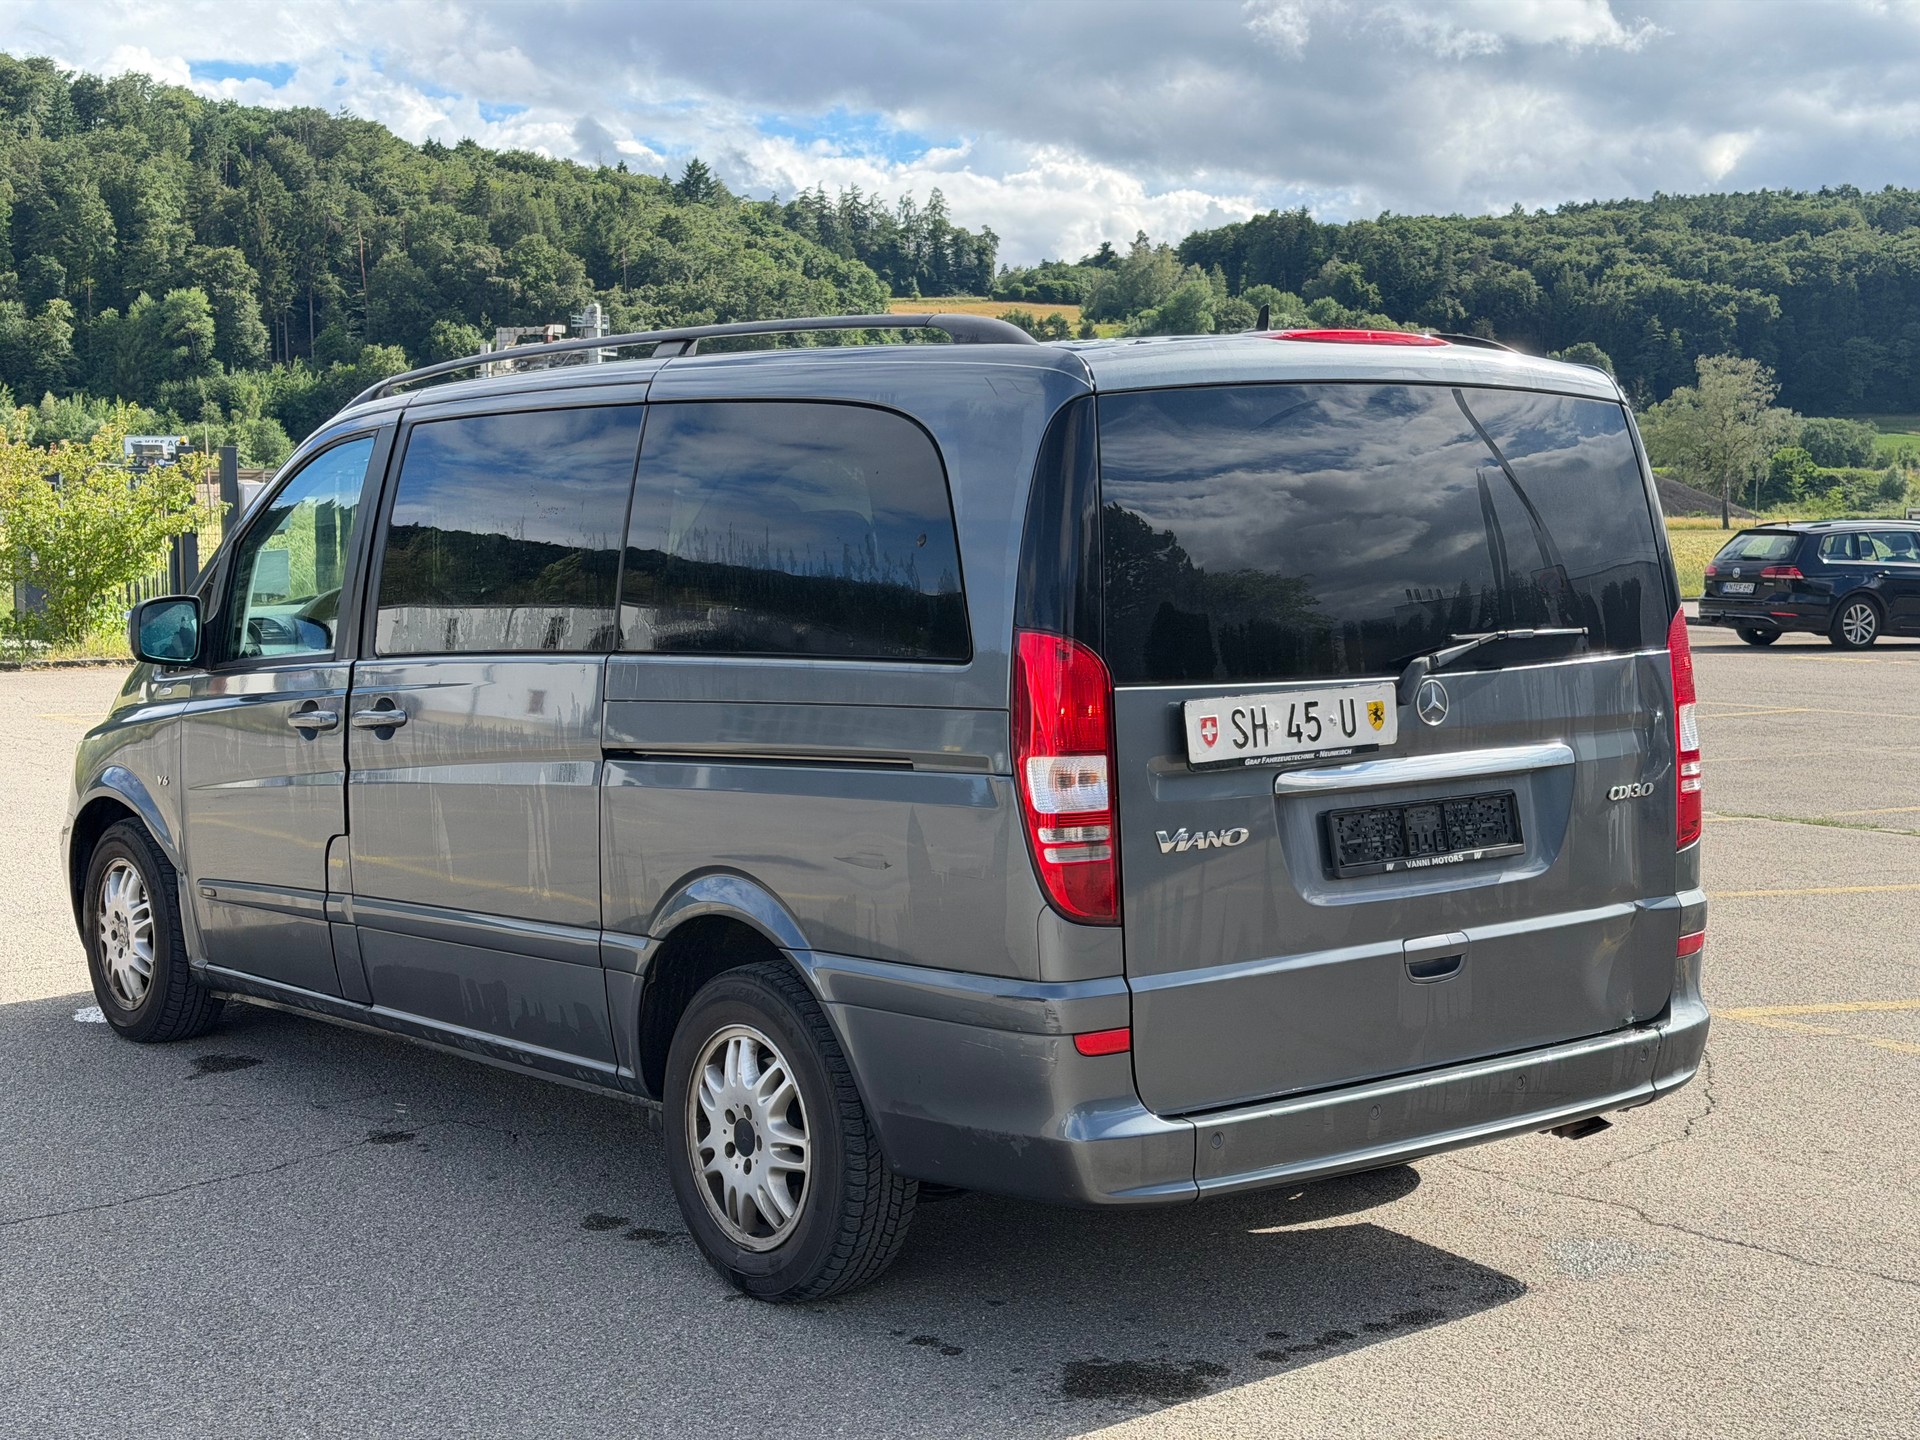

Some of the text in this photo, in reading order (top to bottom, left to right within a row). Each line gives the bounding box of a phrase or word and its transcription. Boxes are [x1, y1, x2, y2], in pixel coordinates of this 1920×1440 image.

[1231, 699, 1357, 749] SH 45 U
[1244, 757, 1261, 766] GRAF
[1261, 752, 1315, 764] FAHRZEUGTECHNIK
[1319, 748, 1353, 758] NEUNKIRCH
[157, 775, 170, 786] V6
[1155, 827, 1250, 854] VIANO
[1405, 854, 1464, 869] VANNI MOTORS
